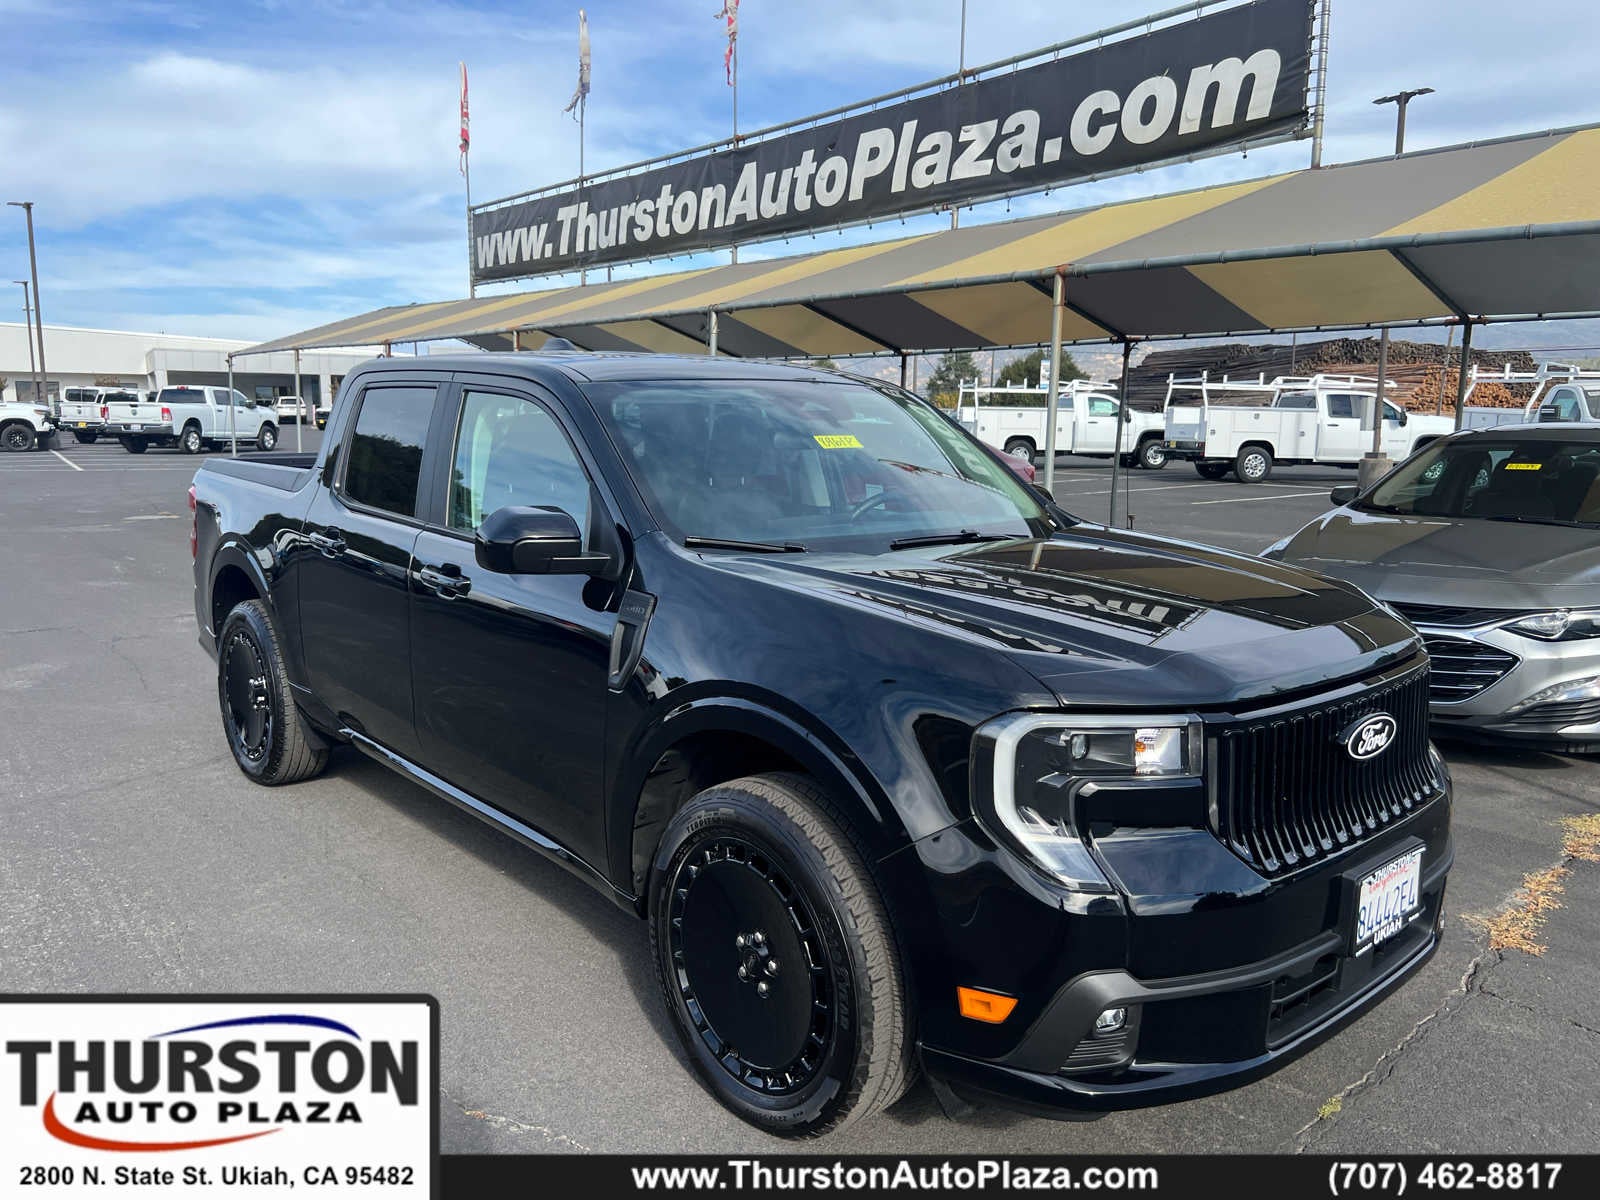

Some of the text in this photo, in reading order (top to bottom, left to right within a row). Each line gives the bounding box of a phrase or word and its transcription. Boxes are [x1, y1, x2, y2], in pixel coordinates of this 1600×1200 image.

[477, 48, 1281, 269] www.ThurstonAutoPlaza.com
[1357, 722, 1389, 755] Ford
[1357, 874, 1416, 940] 84442E4
[1373, 917, 1403, 945] UKIAH
